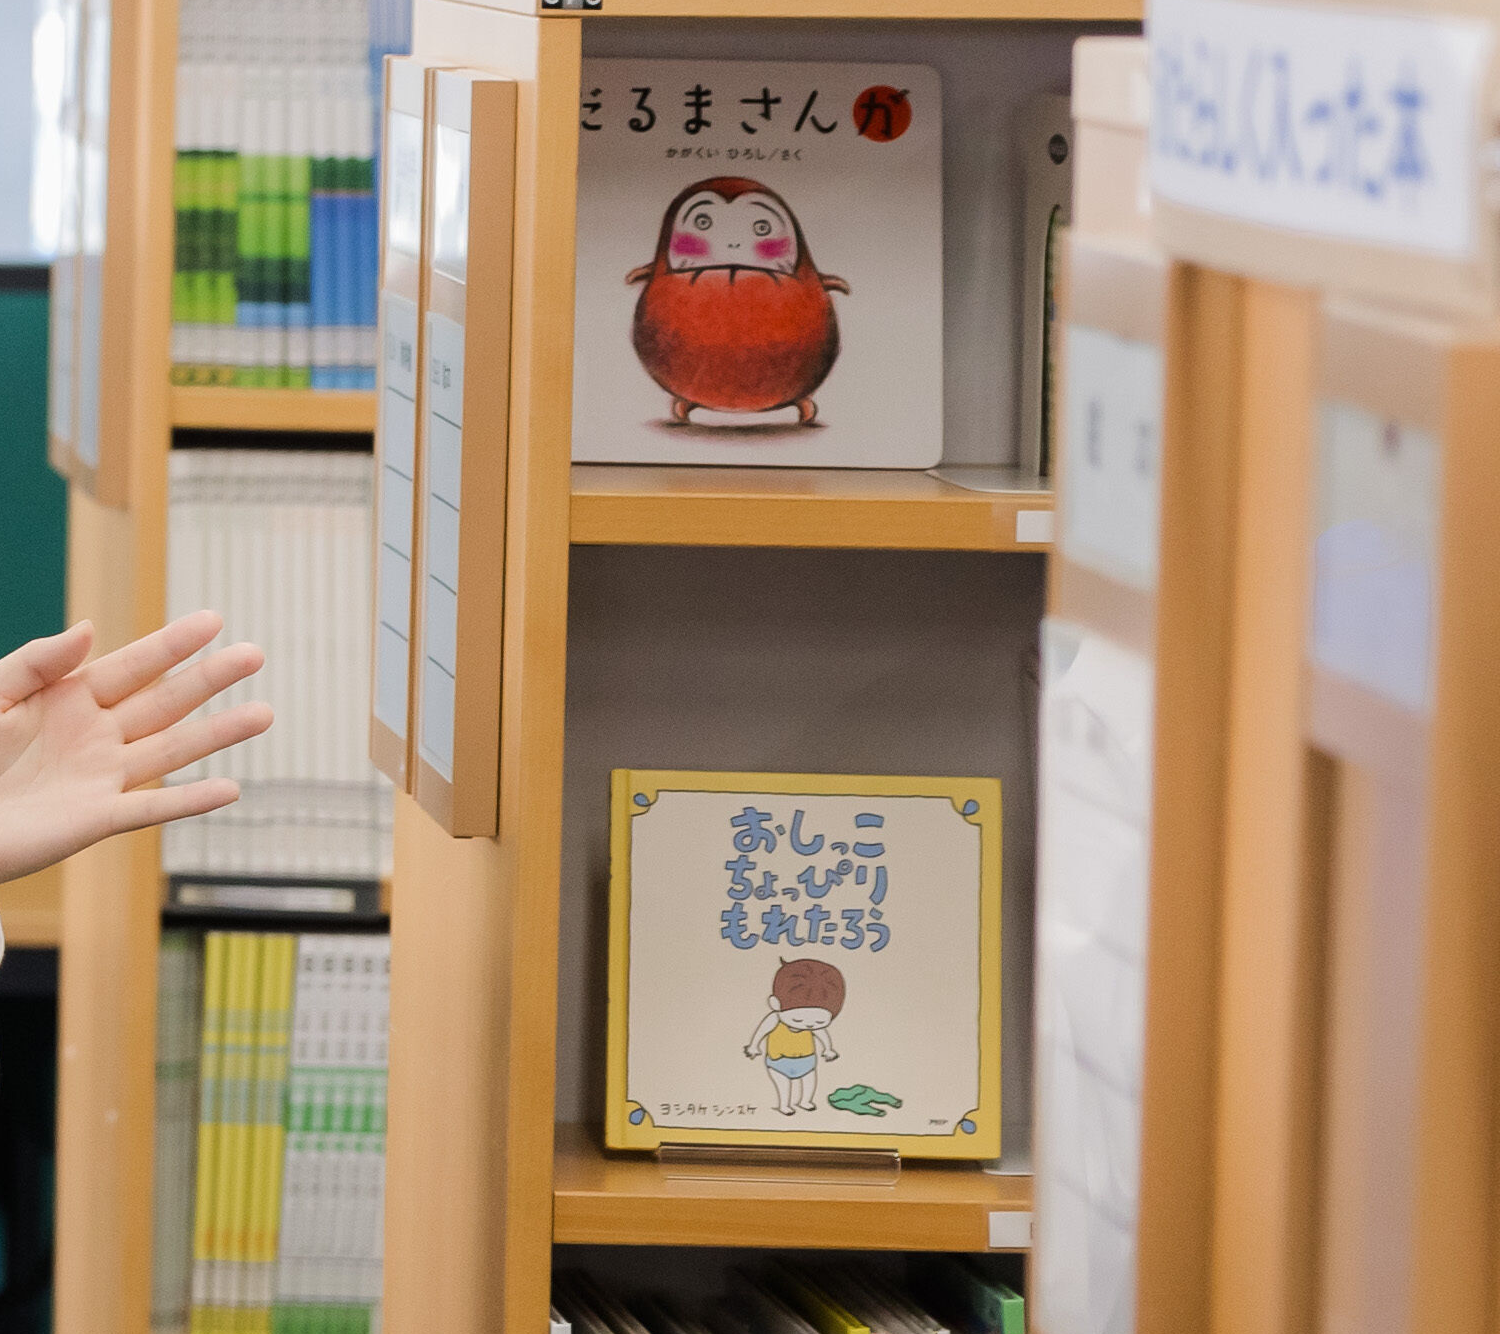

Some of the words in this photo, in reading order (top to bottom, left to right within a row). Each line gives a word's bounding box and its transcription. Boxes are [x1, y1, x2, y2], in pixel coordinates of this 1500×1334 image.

[730, 806, 887, 858] おしっこ
[725, 855, 889, 905] ちょっぴり
[720, 904, 891, 952] もれたろう
[660, 1103, 707, 1115] ヨシタケ
[713, 1105, 757, 1115] シンスケ
